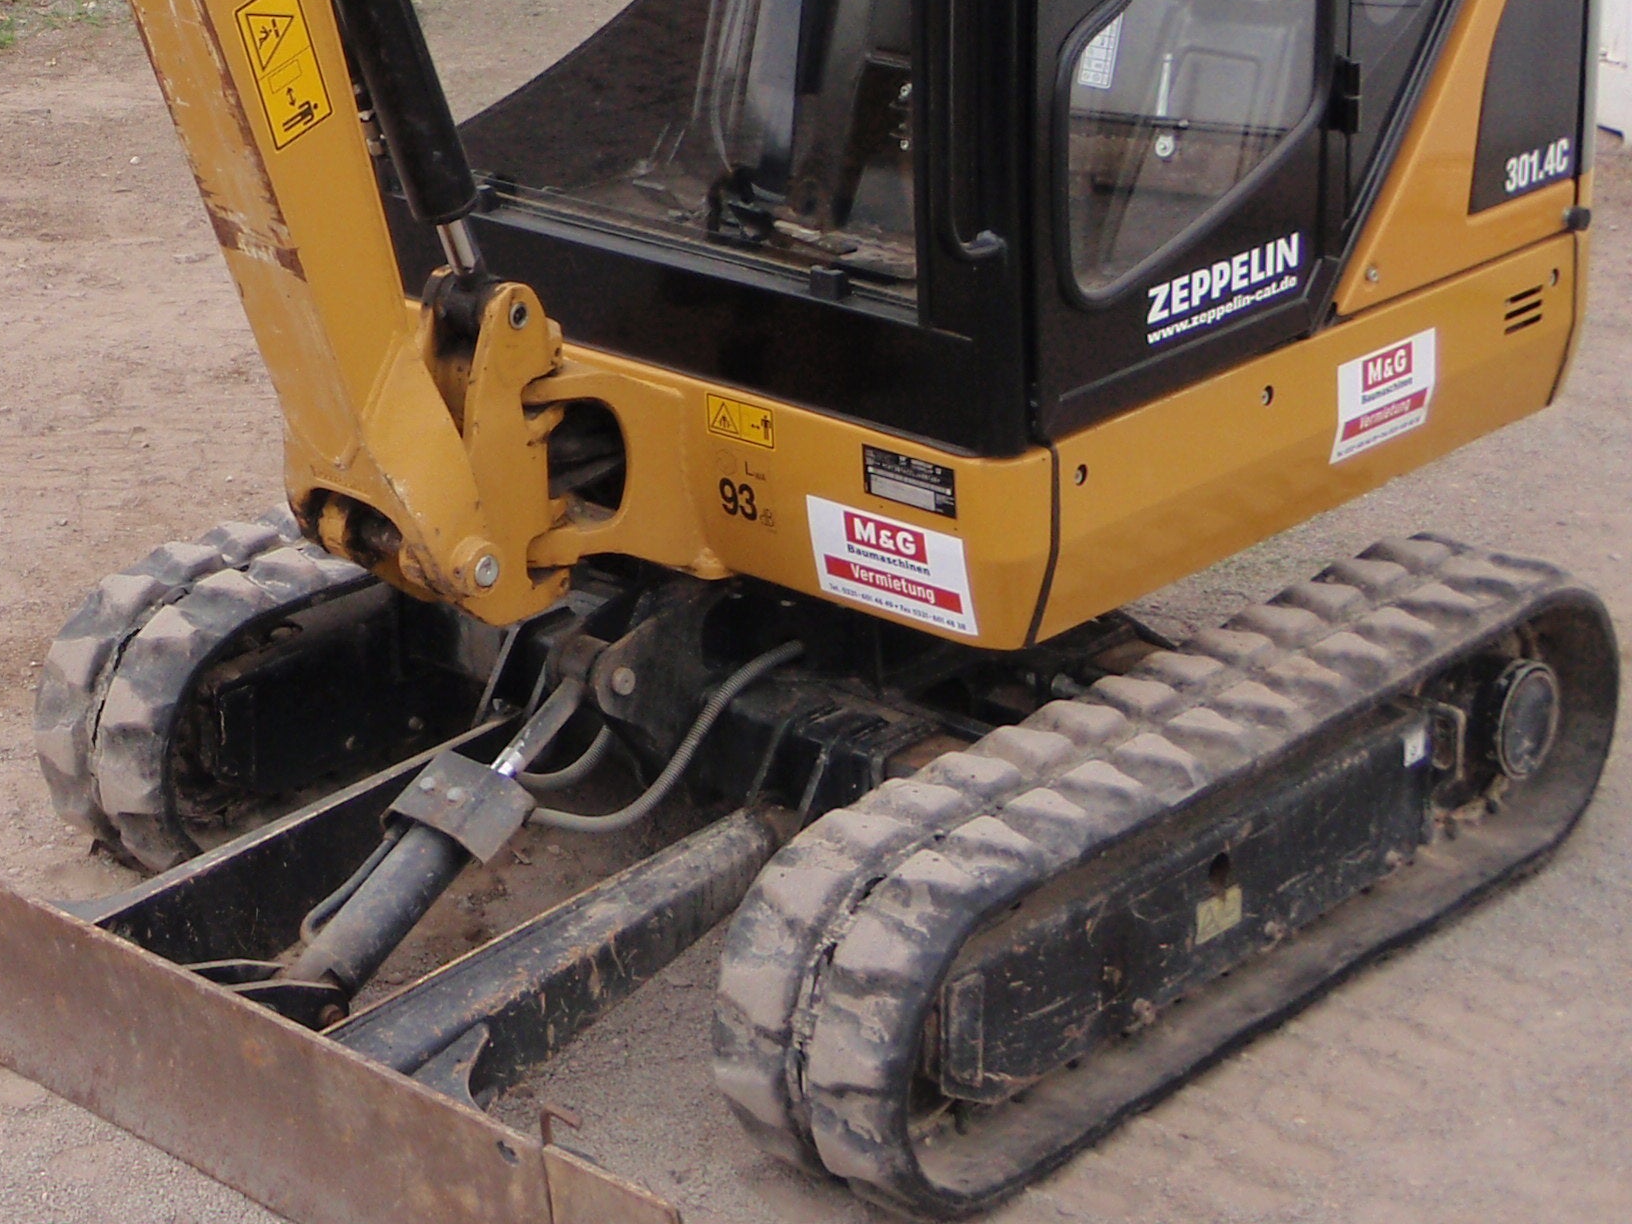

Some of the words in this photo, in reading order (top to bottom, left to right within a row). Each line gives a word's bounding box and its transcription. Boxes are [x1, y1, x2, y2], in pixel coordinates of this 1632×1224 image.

[1505, 137, 1569, 193] 301.4C
[1147, 232, 1299, 325] ZEPPELIN
[1146, 275, 1298, 344] www.zeppelin-cat.de
[1367, 348, 1407, 386] M&G
[719, 477, 758, 522] 93
[853, 517, 917, 556] M&G
[847, 543, 931, 576] Baumaschinen
[850, 563, 936, 604] Vermietung
